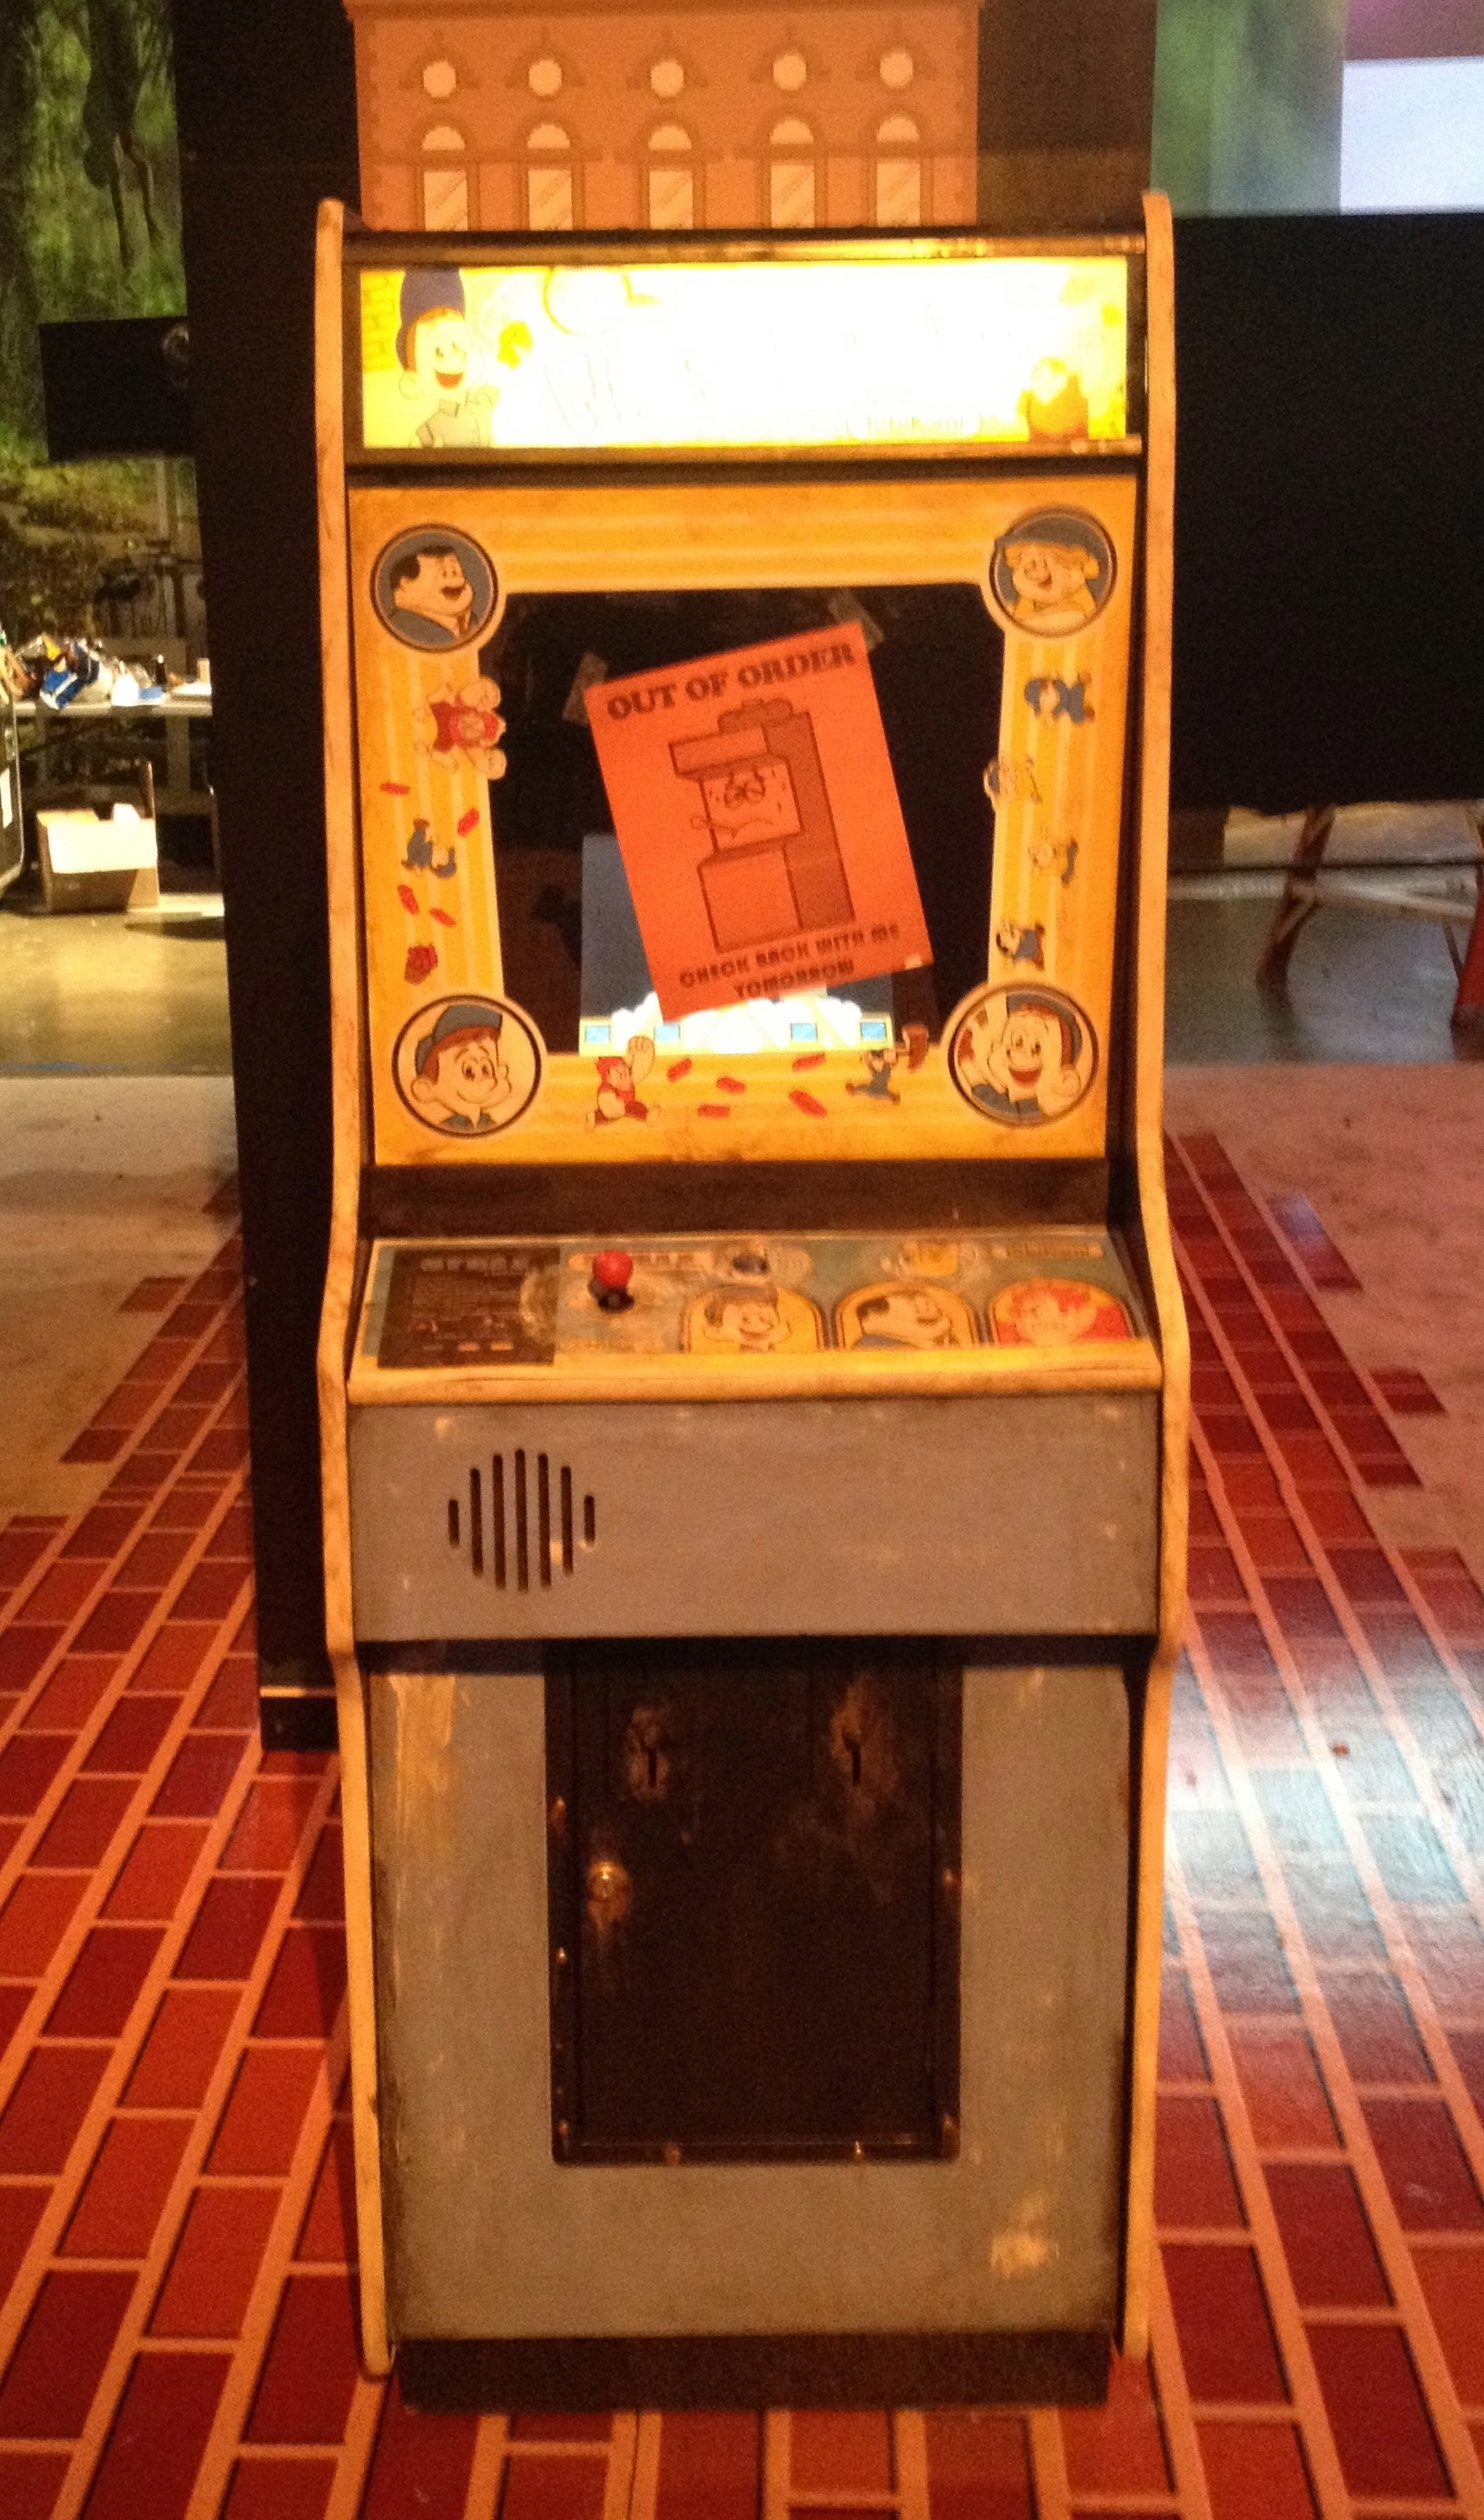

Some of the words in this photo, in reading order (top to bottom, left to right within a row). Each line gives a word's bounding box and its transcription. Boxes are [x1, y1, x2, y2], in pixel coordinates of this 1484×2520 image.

[606, 683, 677, 721] OUT
[685, 671, 728, 702] OF
[737, 642, 855, 689] ORDER
[680, 956, 750, 989] CHECK
[815, 928, 865, 955] WITH
[733, 959, 855, 999] TOMORROW
